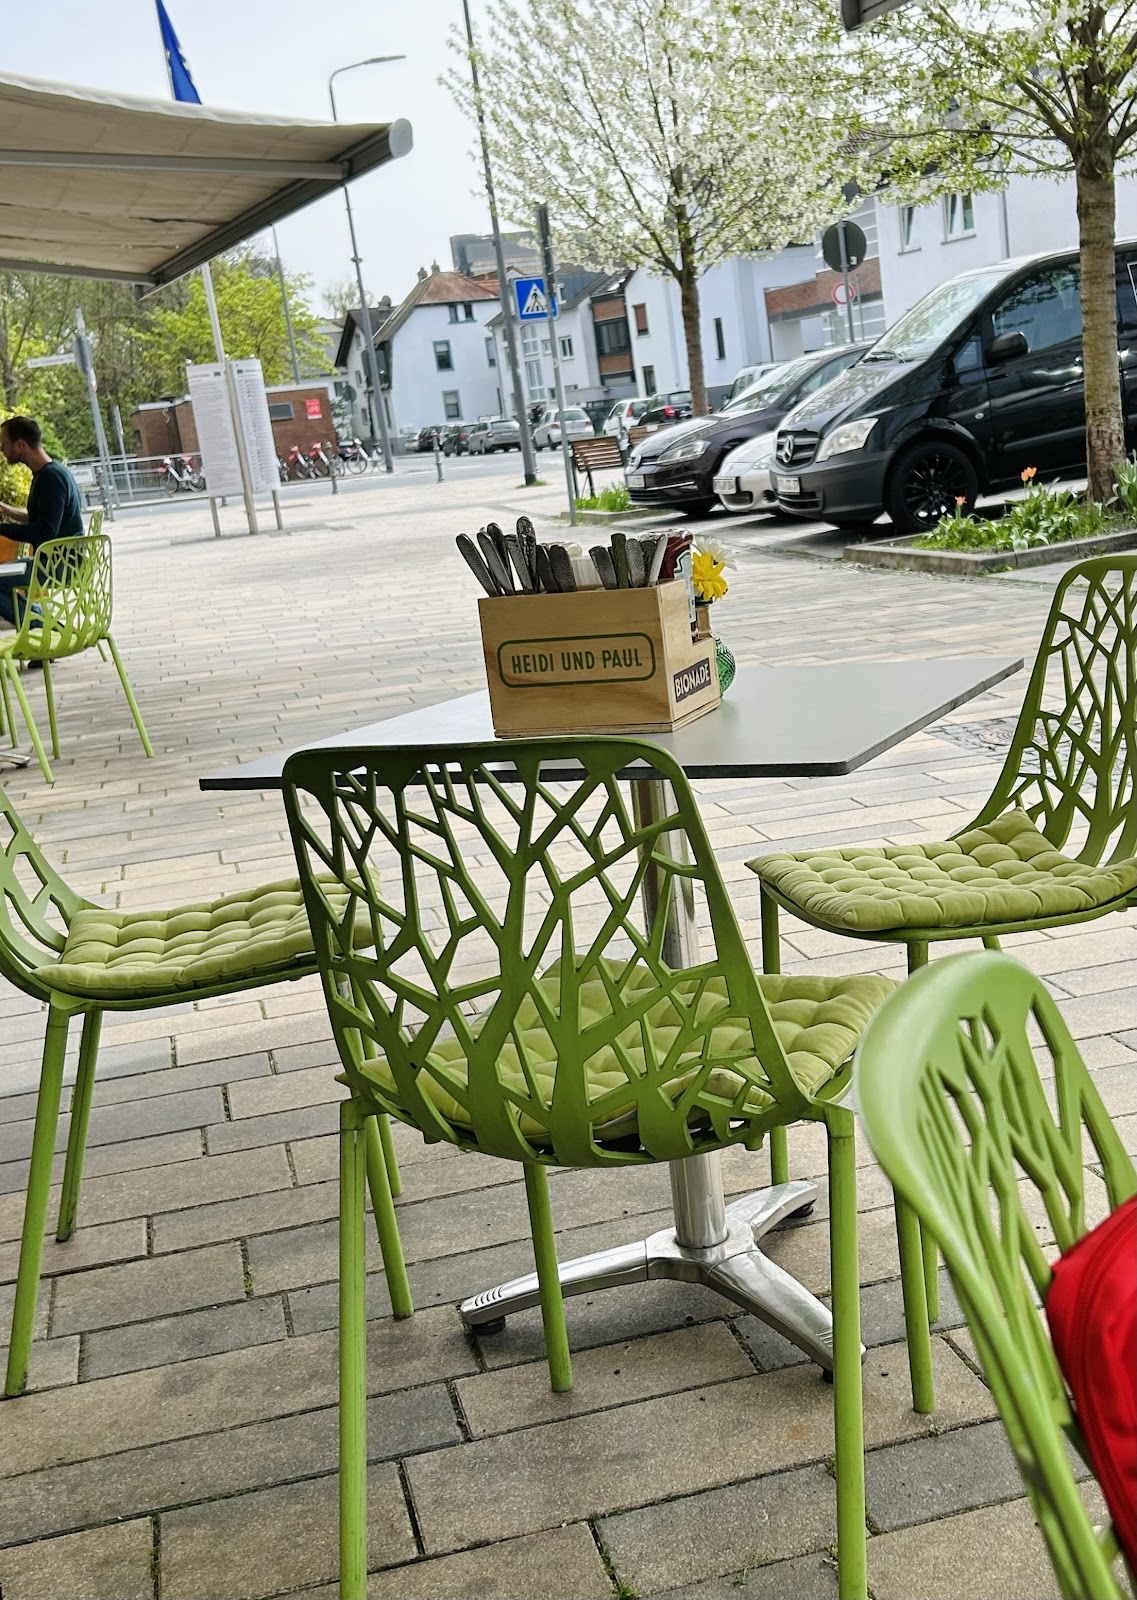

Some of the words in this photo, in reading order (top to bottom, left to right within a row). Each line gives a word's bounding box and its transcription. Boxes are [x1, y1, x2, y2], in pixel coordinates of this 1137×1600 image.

[511, 653, 555, 674] HEIDI
[561, 650, 596, 671] UND
[602, 647, 643, 669] PAUL
[675, 662, 710, 697] BIONADE
